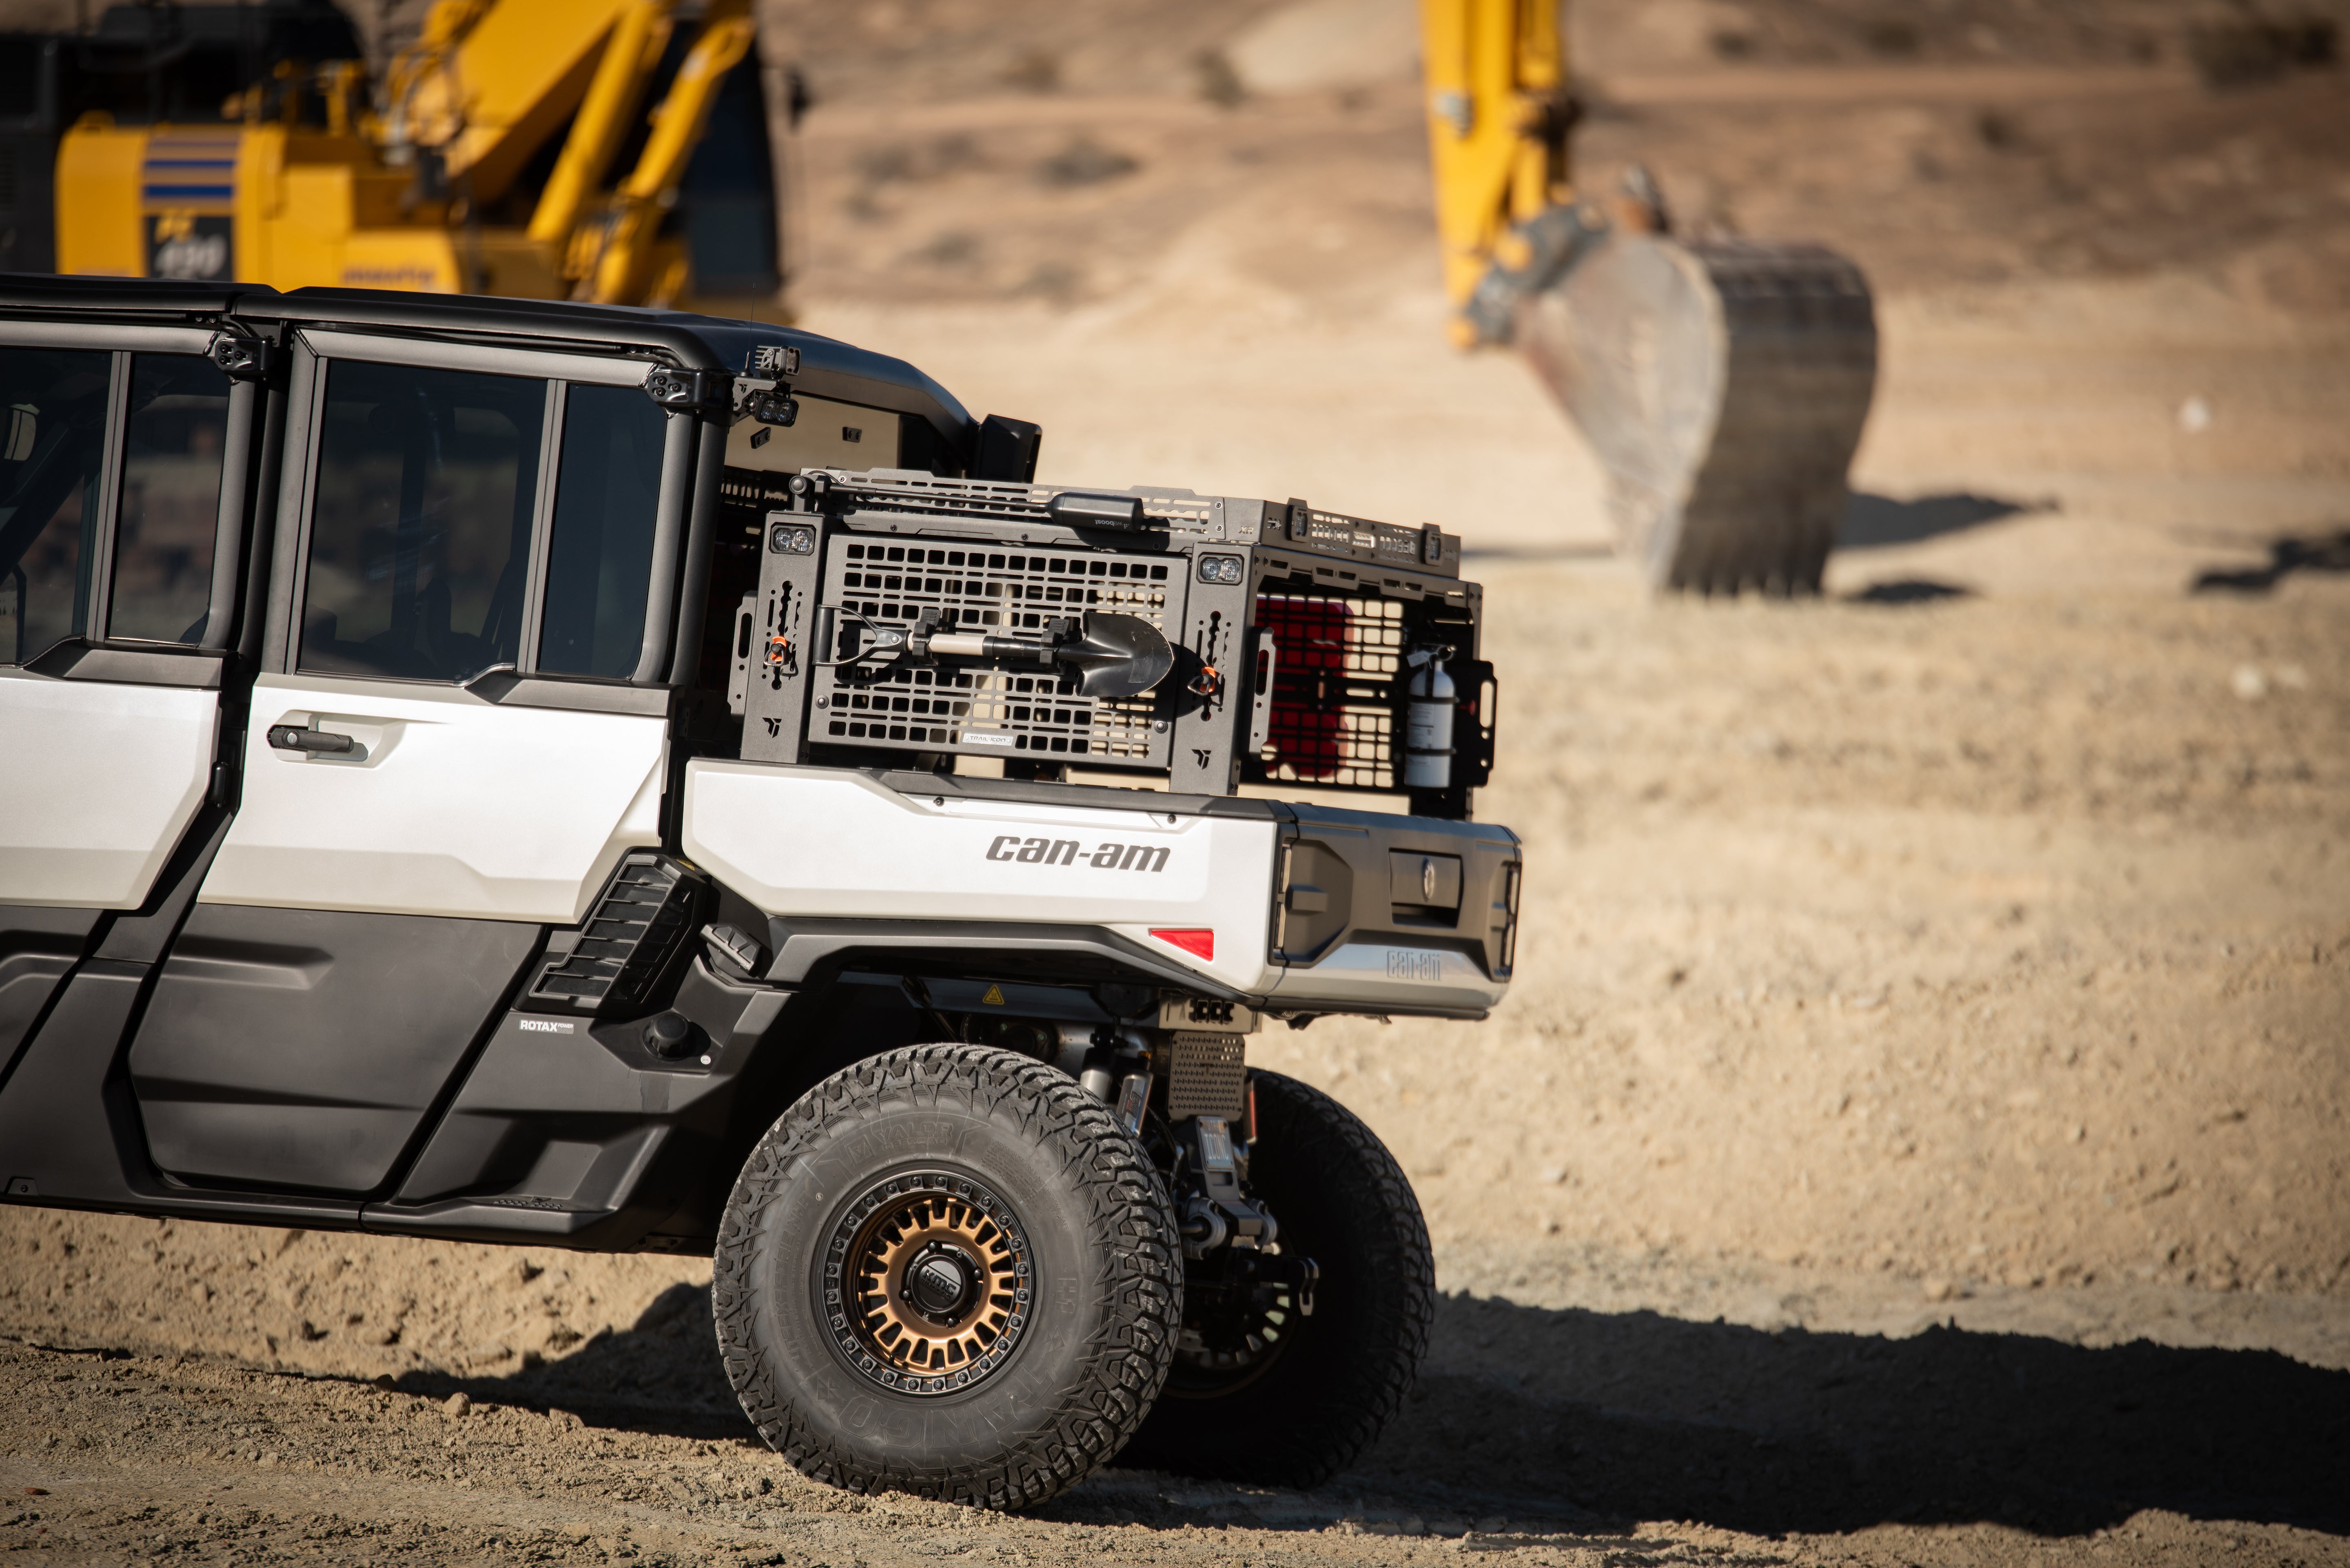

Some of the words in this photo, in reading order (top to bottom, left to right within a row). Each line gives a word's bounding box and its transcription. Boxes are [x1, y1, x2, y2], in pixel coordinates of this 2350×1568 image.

[986, 836, 1171, 872] can-am
[520, 1020, 558, 1032] ROTAX
[871, 1122, 953, 1144] VALOR
[991, 1138, 1003, 1148] FOR
[839, 1362, 1054, 1449] TANGO
